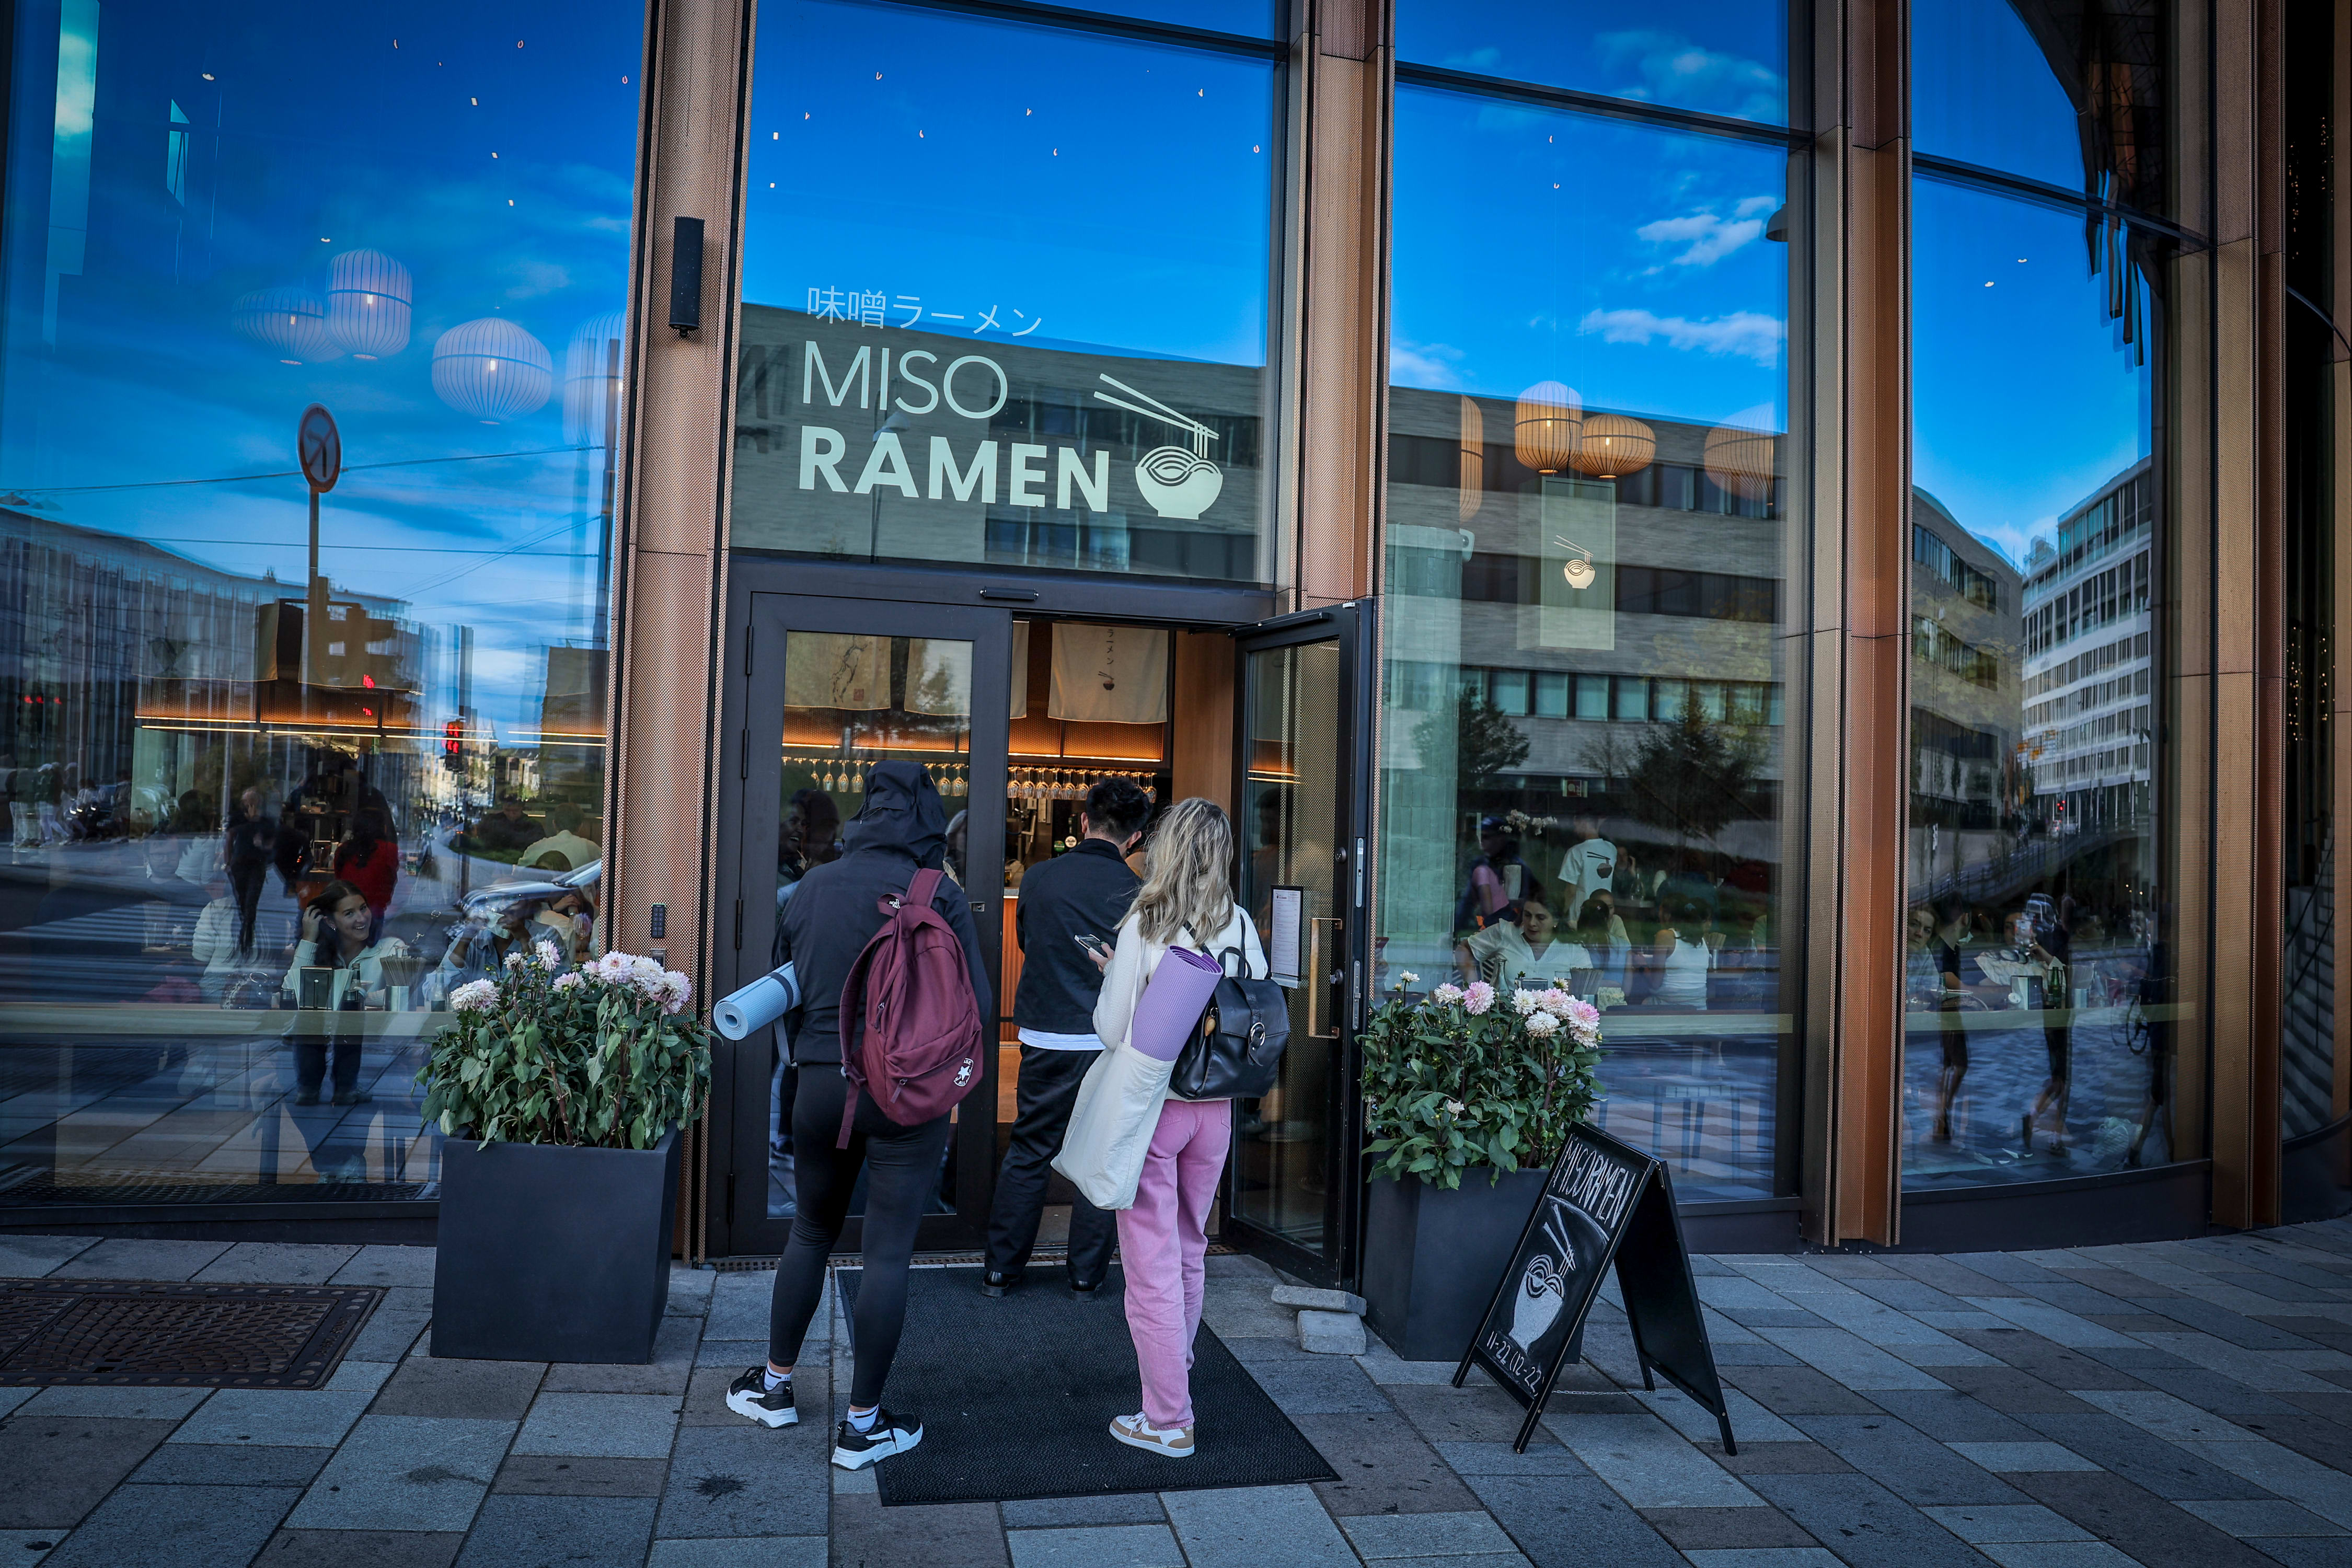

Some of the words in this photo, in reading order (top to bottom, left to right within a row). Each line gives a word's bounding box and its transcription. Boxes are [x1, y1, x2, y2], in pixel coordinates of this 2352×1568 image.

[806, 285, 1042, 337] 味噌ラーメン
[803, 340, 1008, 419] MISO
[799, 425, 1110, 513] RAMEN
